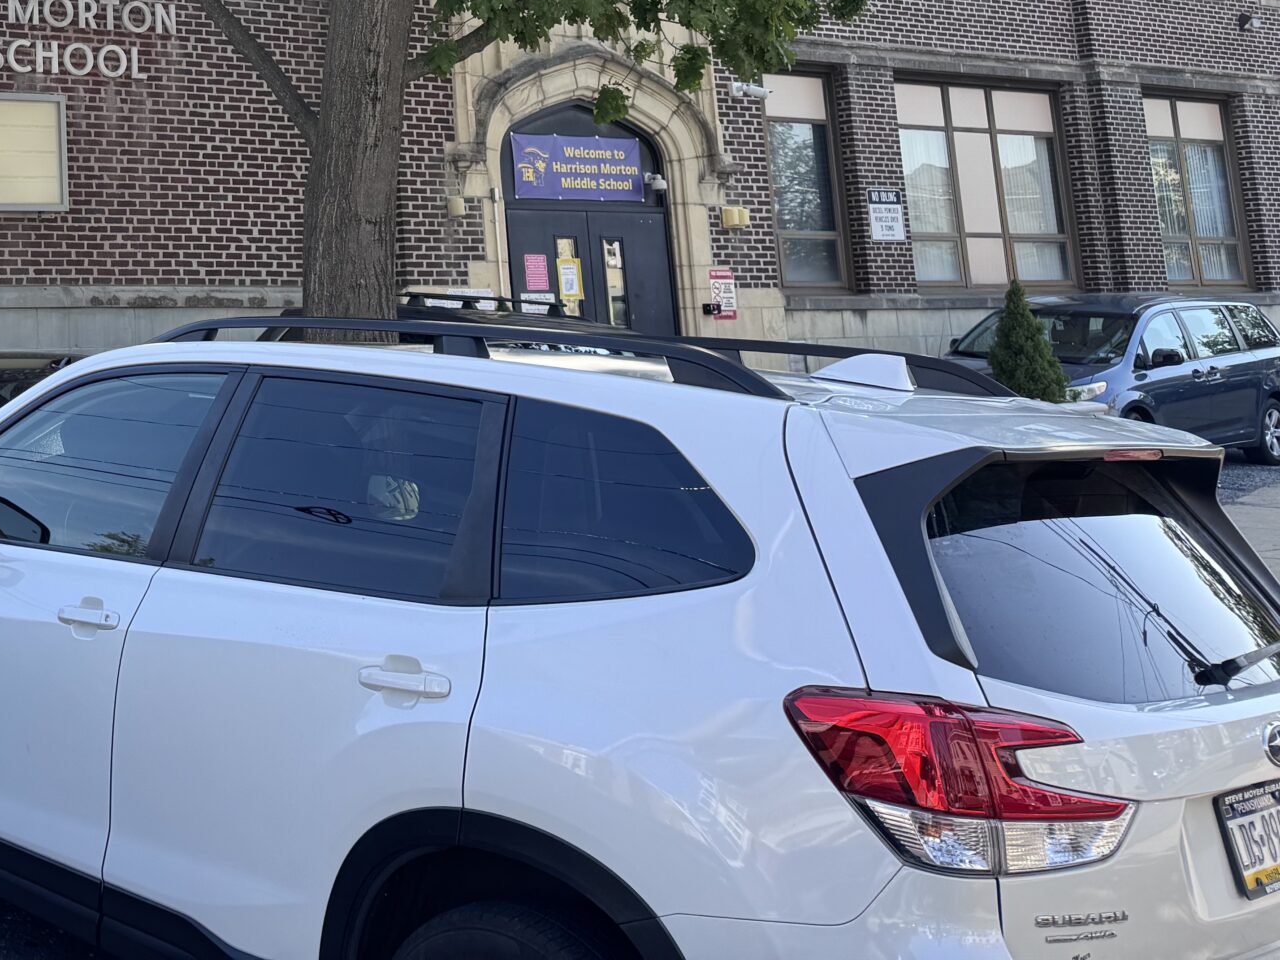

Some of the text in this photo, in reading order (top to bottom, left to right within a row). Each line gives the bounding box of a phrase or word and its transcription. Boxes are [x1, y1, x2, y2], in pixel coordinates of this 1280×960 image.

[563, 146, 625, 160] Welcome to
[552, 161, 638, 175] Harrison Morton
[561, 177, 633, 190] Middle School
[871, 191, 897, 202] NO IDLING
[1224, 793, 1244, 805] STEVE
[1243, 787, 1264, 800] MOYER
[1034, 910, 1129, 928] SUBARU
